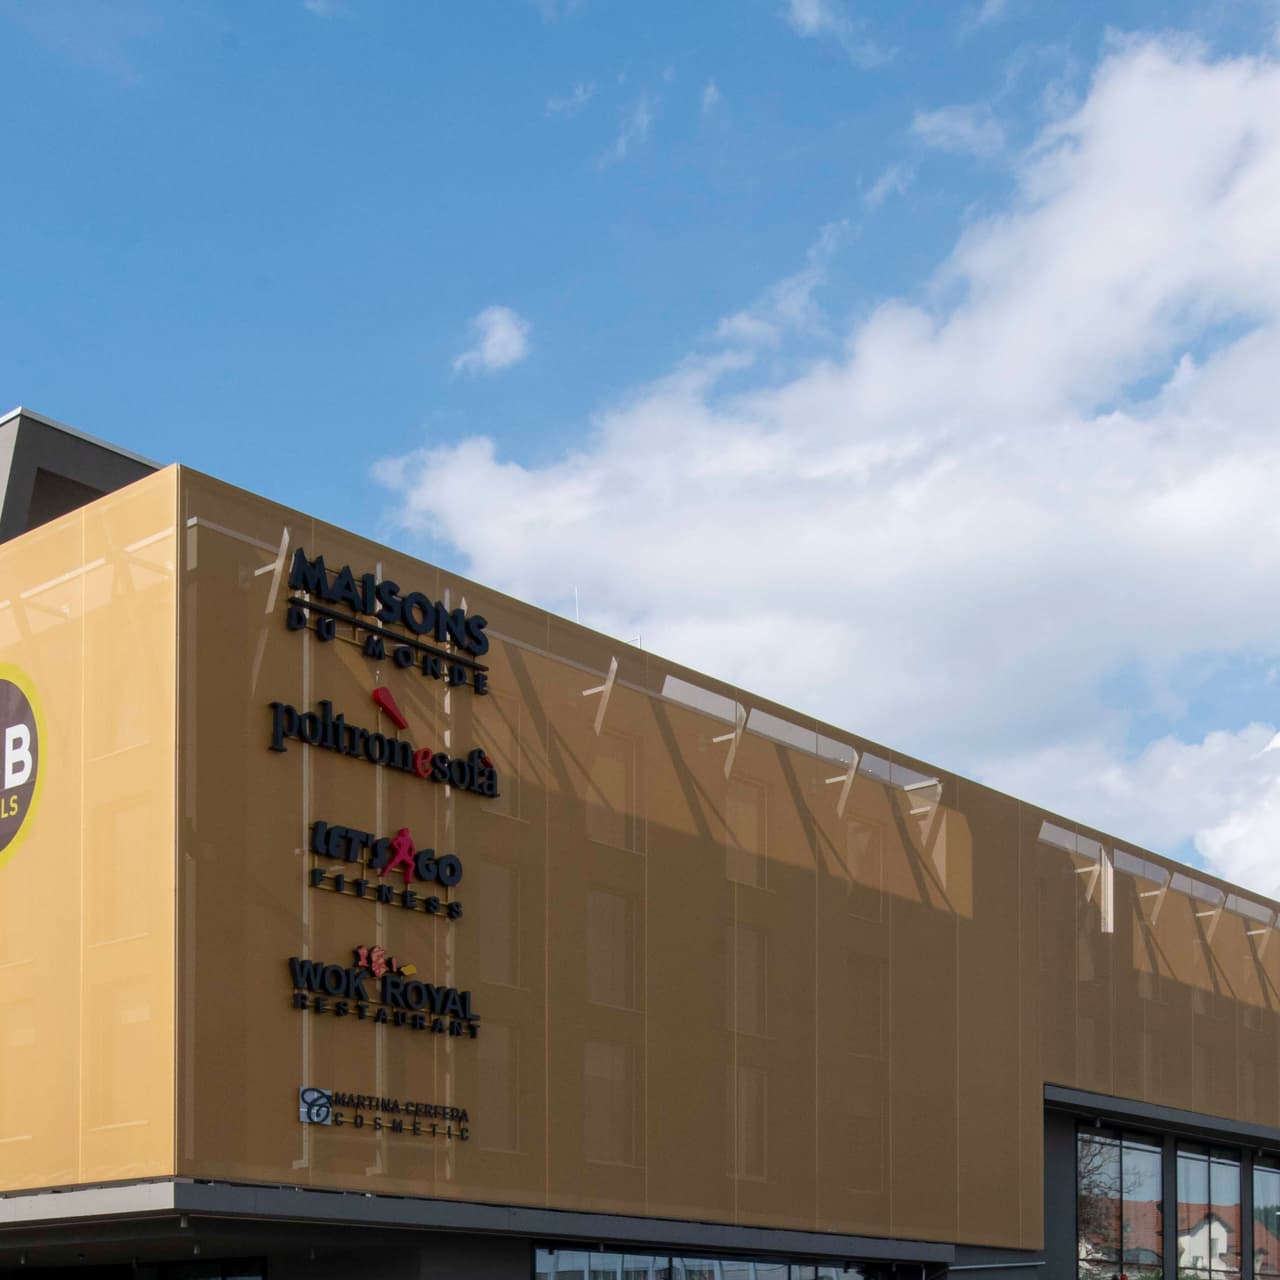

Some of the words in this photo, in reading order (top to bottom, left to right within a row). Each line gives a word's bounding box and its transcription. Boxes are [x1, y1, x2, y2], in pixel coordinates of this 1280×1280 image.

[287, 547, 490, 656] MAISONS
[286, 606, 337, 642] DU
[362, 633, 489, 696] MONDE
[310, 820, 390, 870] LET'S
[416, 848, 463, 887] GO
[310, 868, 464, 921] FITNESS
[288, 956, 370, 1001] WOK
[380, 975, 481, 1021] ROYAL
[291, 992, 481, 1040] RESTAURANT
[333, 1091, 401, 1115] MARTINA
[333, 1111, 470, 1142] COSMETIC
